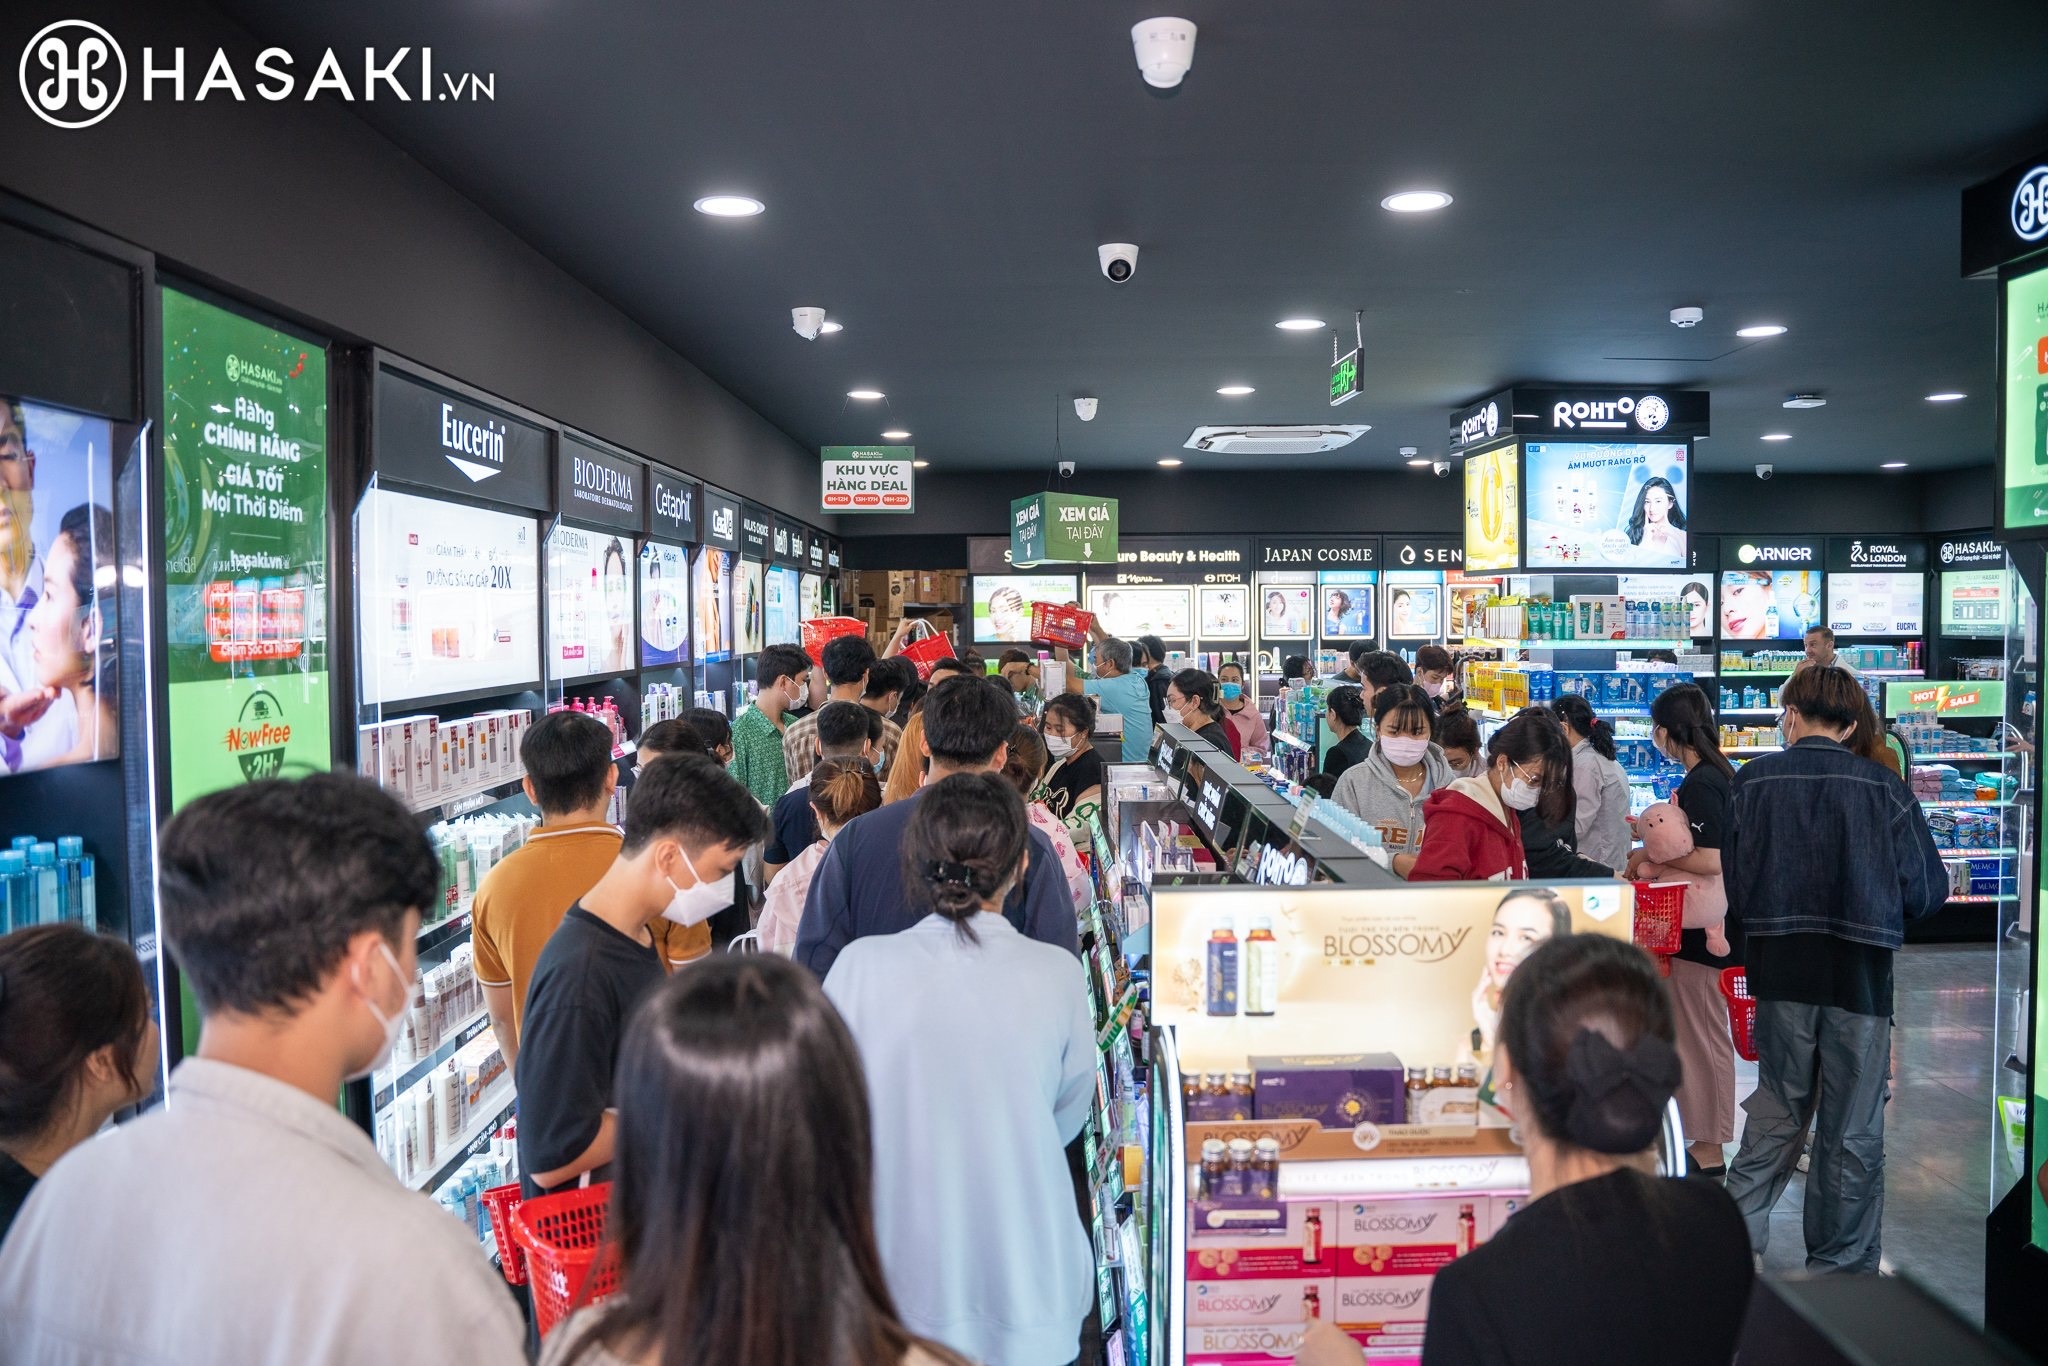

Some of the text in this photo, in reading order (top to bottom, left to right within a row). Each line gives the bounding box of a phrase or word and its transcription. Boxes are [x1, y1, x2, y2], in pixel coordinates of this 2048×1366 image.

[235, 397, 275, 431] Hàng
[1554, 397, 1635, 428] ROHTO
[442, 403, 505, 463] Eucerin
[1461, 407, 1487, 444] ROHTO
[204, 422, 300, 462] CHÍNH HÃNG
[225, 461, 284, 493] GIÁ TỐT
[574, 457, 633, 500] BIODERMA
[836, 463, 898, 478] KHU VỰC
[827, 478, 908, 491] HÀNG DEAL
[202, 488, 303, 522] Mọi Thời Điểm
[655, 483, 692, 527] Cetaphil
[1016, 499, 1040, 527] XEM GIÁ
[1058, 503, 1110, 522] XEM GIÁ
[553, 528, 589, 549] BIODERMA
[1019, 523, 1038, 544] TẠI ĐÂY
[1066, 524, 1104, 542] TẠI ĐÂY
[1140, 550, 1183, 564] Beauty
[1186, 550, 1196, 562] &
[1199, 550, 1241, 562] Health
[1265, 547, 1373, 562] JAPAN COSME
[1738, 545, 1812, 563] ARNIER
[1870, 545, 1899, 553] ROYAL
[1955, 541, 2002, 554] HASAKI.VN
[491, 565, 512, 589] 20X
[1217, 574, 1241, 582] ITOH
[1896, 622, 1918, 630] EUCRYL
[1913, 690, 1976, 707] HOT SALE
[252, 752, 274, 780] 2H
[1324, 926, 1473, 964] BLOSSOMY
[1354, 1213, 1438, 1235] BLOSSOMY
[1197, 1294, 1281, 1316] BLOSSOMY
[1342, 1288, 1425, 1309] BLOSSOMY
